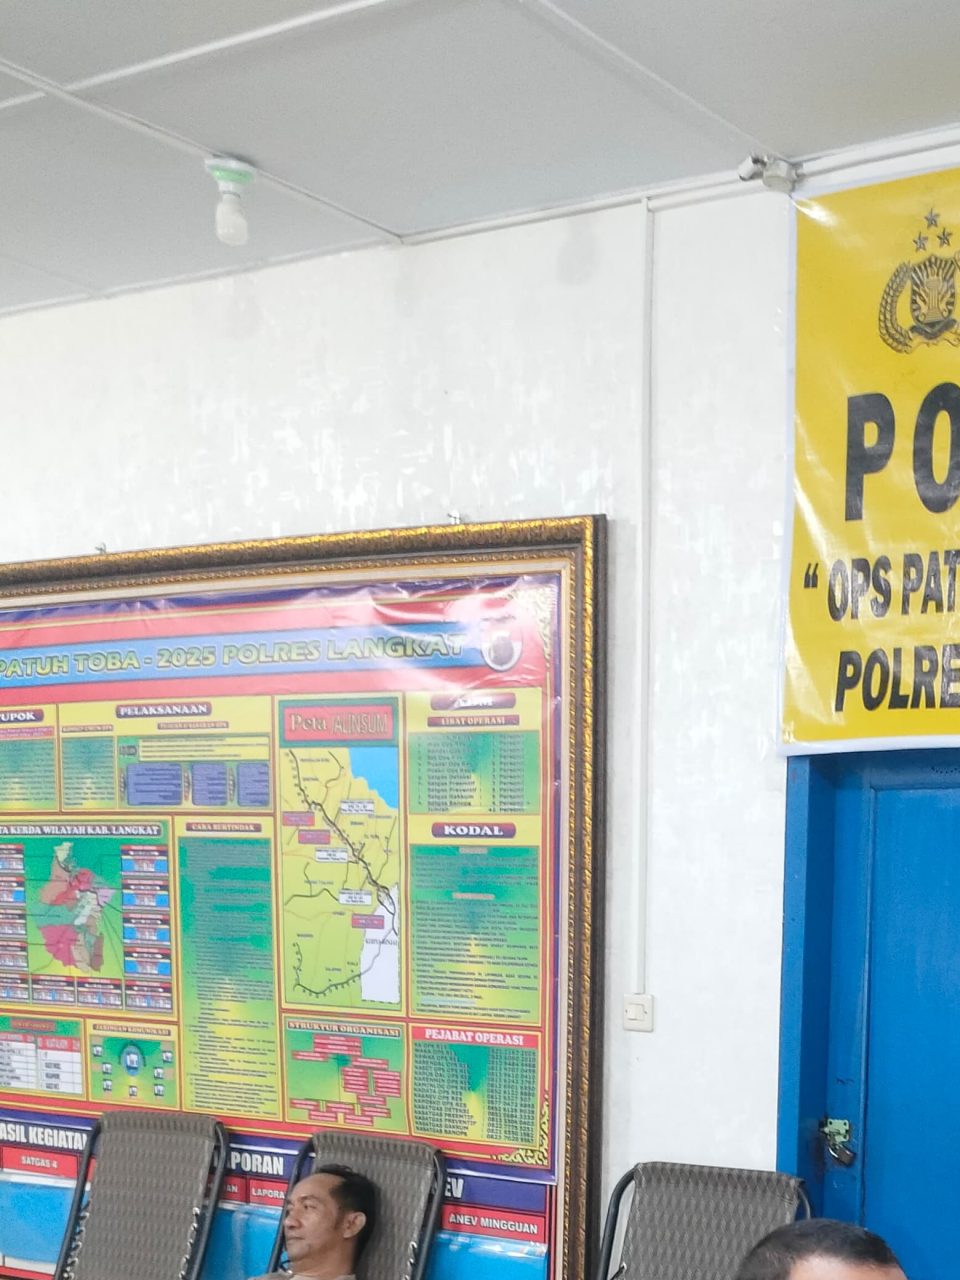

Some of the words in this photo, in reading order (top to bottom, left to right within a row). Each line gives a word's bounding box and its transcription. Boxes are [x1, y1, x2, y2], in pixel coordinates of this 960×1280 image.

[74, 650, 141, 673] TOBA
[157, 646, 217, 669] 2025
[222, 640, 321, 665] POLRES
[326, 634, 466, 662] LANGKAT
[120, 704, 207, 716] PELAKSANAAN
[290, 714, 327, 730] Peta
[43, 825, 86, 835] WILAYAH
[112, 825, 160, 835] LANGKAT
[444, 824, 503, 836] KODAL
[288, 1021, 339, 1032] STRUKTUR
[340, 1025, 399, 1037] ORGANISASI
[425, 1028, 474, 1042] PEJABAT
[475, 1032, 524, 1046] OPERASI
[21, 1156, 50, 1168] SATGAS
[227, 1151, 284, 1176] PORAN
[252, 1187, 286, 1199] LAPORA
[449, 1213, 478, 1226] ANEV
[480, 1217, 538, 1235] MINGGUAN
